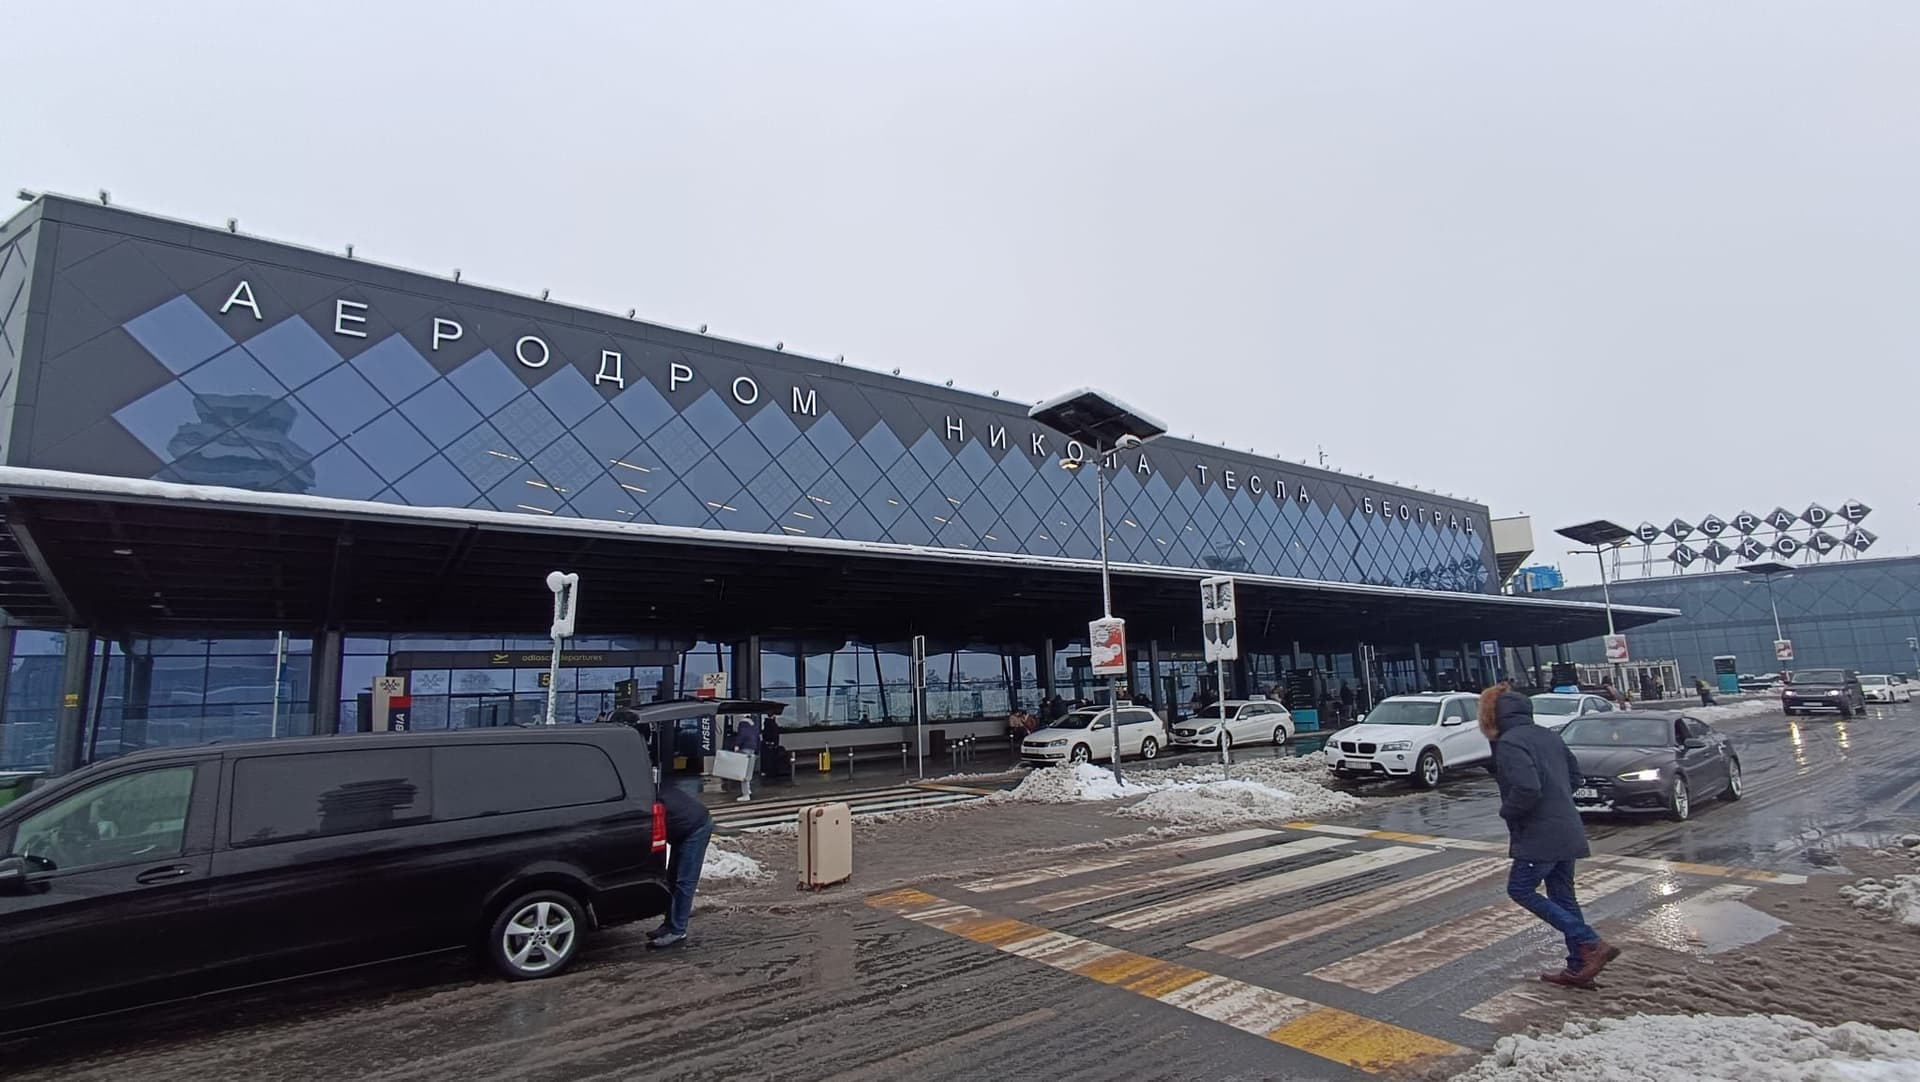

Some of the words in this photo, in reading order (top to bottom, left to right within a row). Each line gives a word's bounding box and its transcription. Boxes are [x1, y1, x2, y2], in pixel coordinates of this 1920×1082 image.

[219, 280, 817, 416] АЕРОДРОМ
[945, 414, 1151, 475] НИКОЛА
[1196, 464, 1310, 503] ТЕСЛА
[1363, 496, 1474, 535] БЕОГРАД
[1640, 503, 1864, 541] ELGRADE
[1676, 533, 1871, 562] NIKOLA
[521, 653, 552, 662] odlasc
[542, 674, 551, 686] 5
